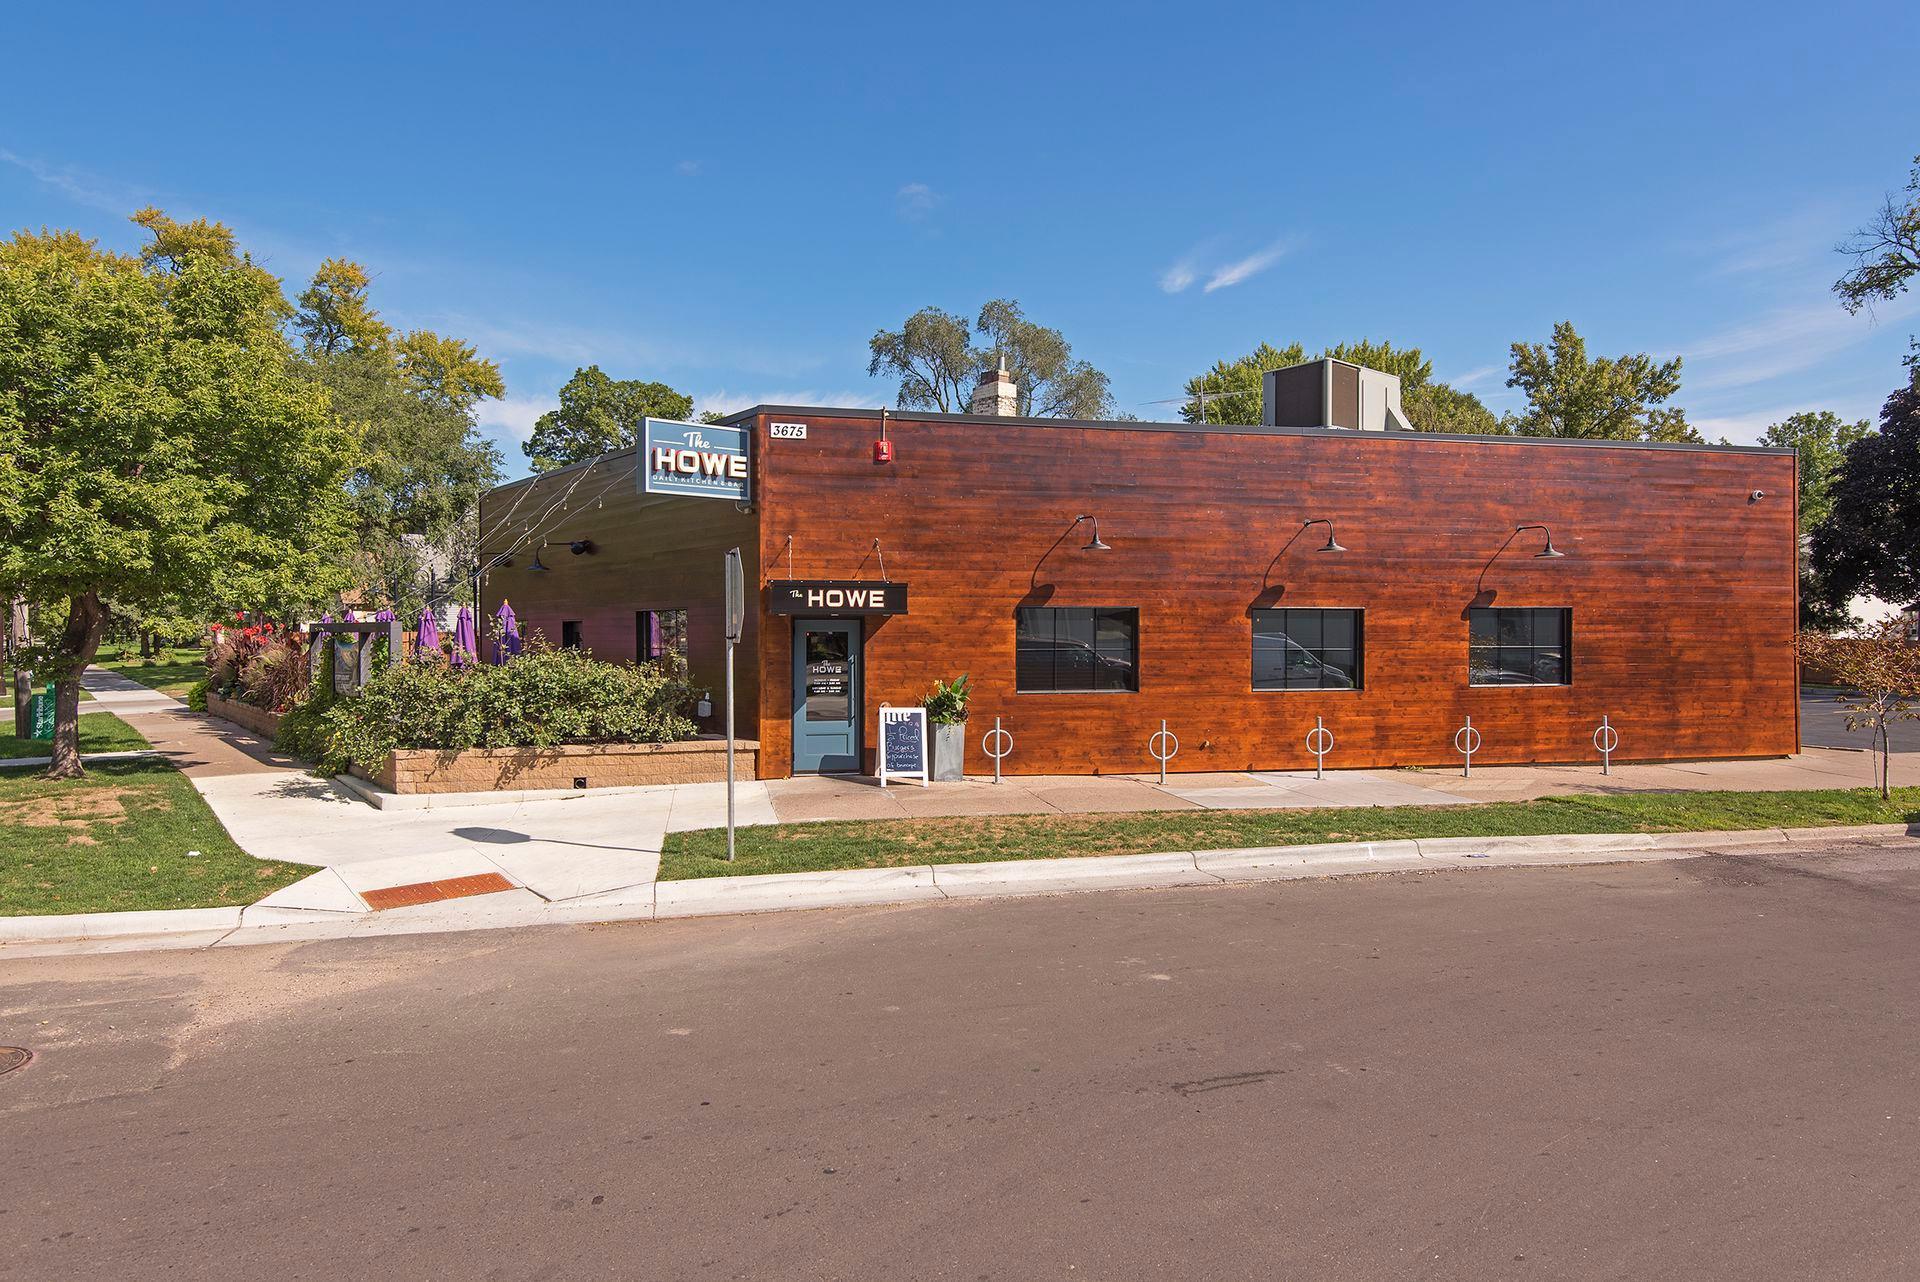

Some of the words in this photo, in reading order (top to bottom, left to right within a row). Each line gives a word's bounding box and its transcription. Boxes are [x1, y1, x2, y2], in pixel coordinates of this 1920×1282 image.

[773, 425, 804, 437] 3675
[683, 431, 711, 449] The
[652, 447, 747, 478] HOWE
[652, 474, 679, 482] DAILY
[681, 477, 719, 486] KITCHEN
[789, 589, 803, 598] The
[808, 589, 885, 608] HOWE
[812, 666, 842, 674] HOWE
